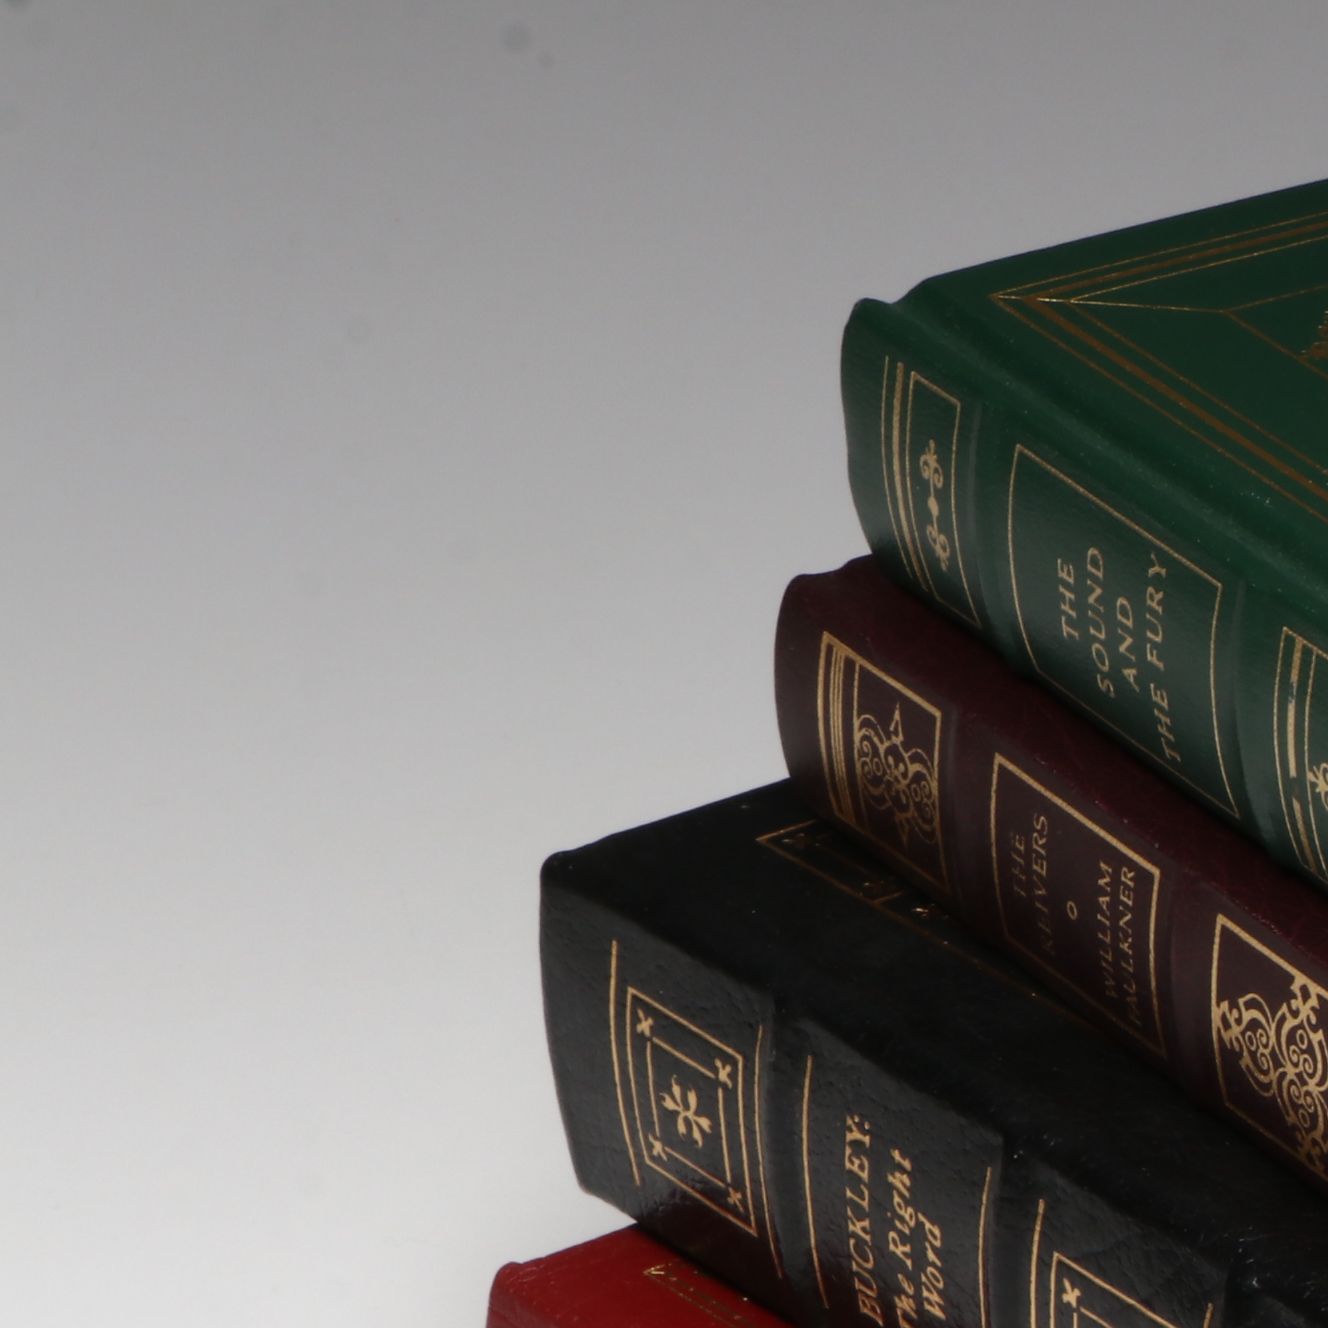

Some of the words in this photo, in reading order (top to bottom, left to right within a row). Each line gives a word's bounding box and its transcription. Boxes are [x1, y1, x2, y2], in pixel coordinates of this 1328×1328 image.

[1057, 557, 1080, 640] THE
[1086, 547, 1116, 698] SOUND
[1116, 596, 1140, 693] AND
[1146, 552, 1167, 671] FURY
[1149, 683, 1181, 762] THE
[1008, 831, 1027, 897] THE
[1097, 860, 1117, 999] WILLIAM
[1118, 866, 1142, 1027] FAULKNER
[844, 1114, 884, 1328] BUCKLEY:
[887, 1148, 917, 1271] Right
[917, 1212, 947, 1321] Word
